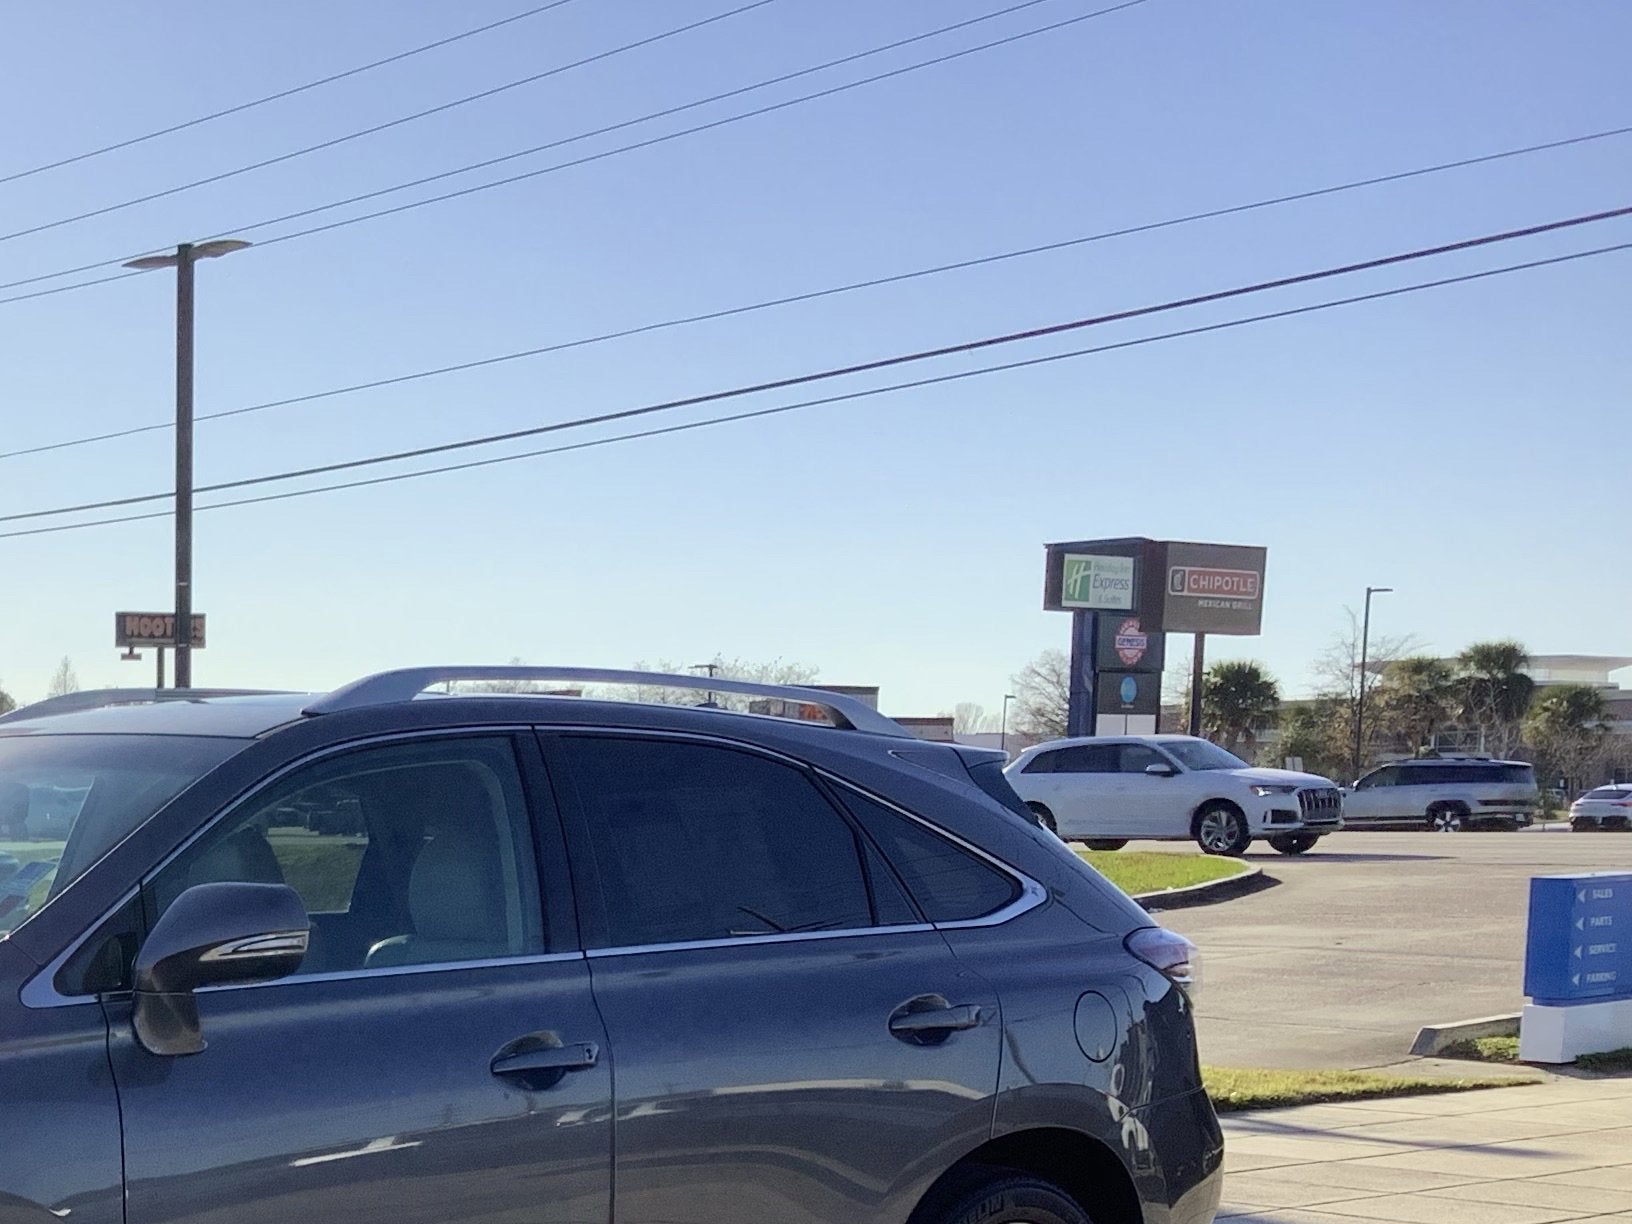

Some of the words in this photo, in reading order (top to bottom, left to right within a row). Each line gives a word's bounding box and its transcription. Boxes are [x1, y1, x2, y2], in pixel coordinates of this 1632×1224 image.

[1092, 573, 1130, 592] Express
[1190, 574, 1256, 592] CHIPOTLE
[1198, 599, 1230, 609] MEXICAN
[125, 615, 205, 639] HOOTS
[1592, 888, 1614, 899] SALES
[1590, 916, 1613, 927] PARTS
[1588, 943, 1617, 955] SERVICE
